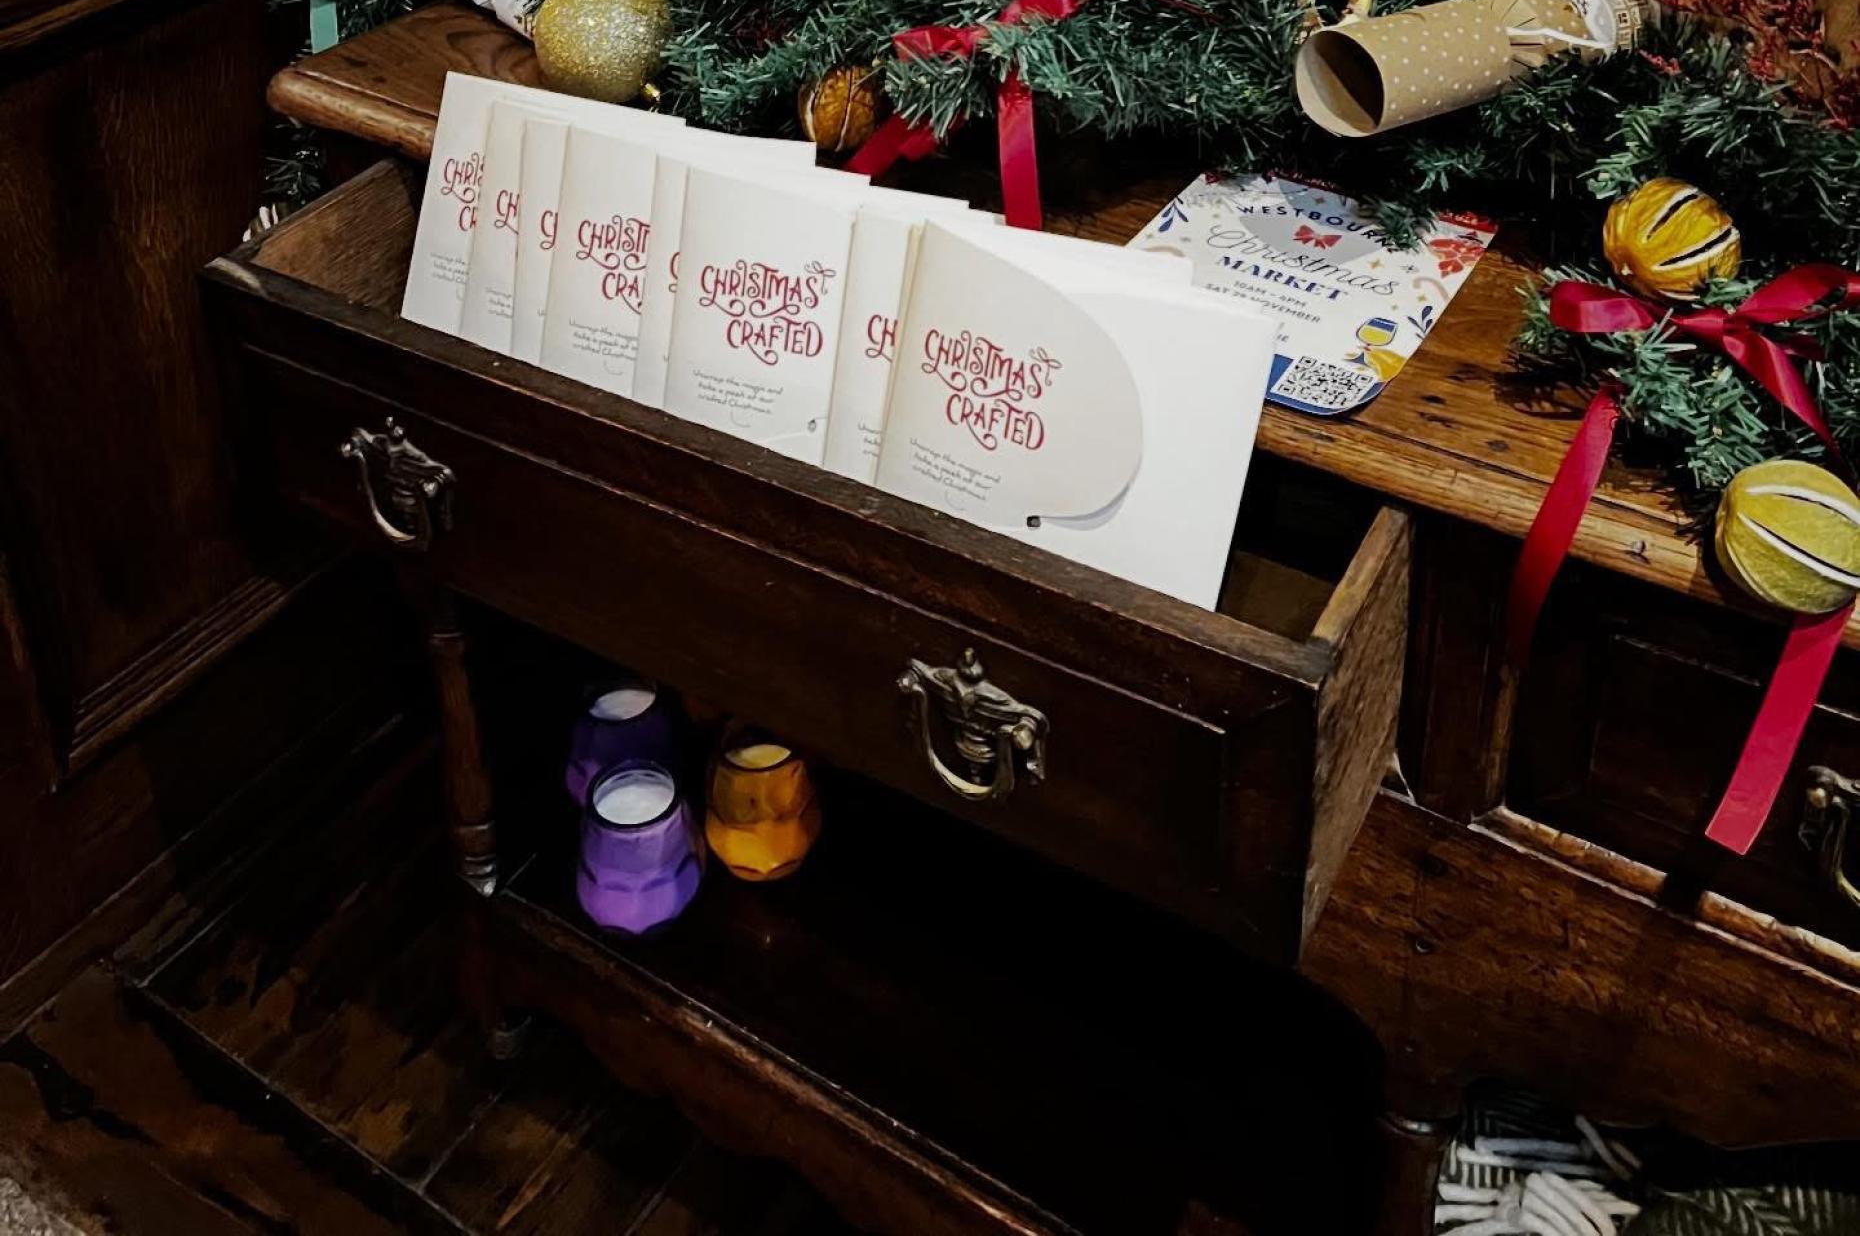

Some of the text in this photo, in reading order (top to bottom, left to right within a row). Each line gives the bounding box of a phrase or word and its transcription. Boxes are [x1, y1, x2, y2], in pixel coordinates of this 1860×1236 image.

[699, 258, 820, 319] CHRISTMAS
[1207, 224, 1399, 296] Christmas
[1216, 256, 1349, 300] MARKET
[727, 315, 824, 366] CRAFTED
[920, 329, 1043, 402] CHRISTMAS
[946, 393, 1045, 451] CRAFTED
